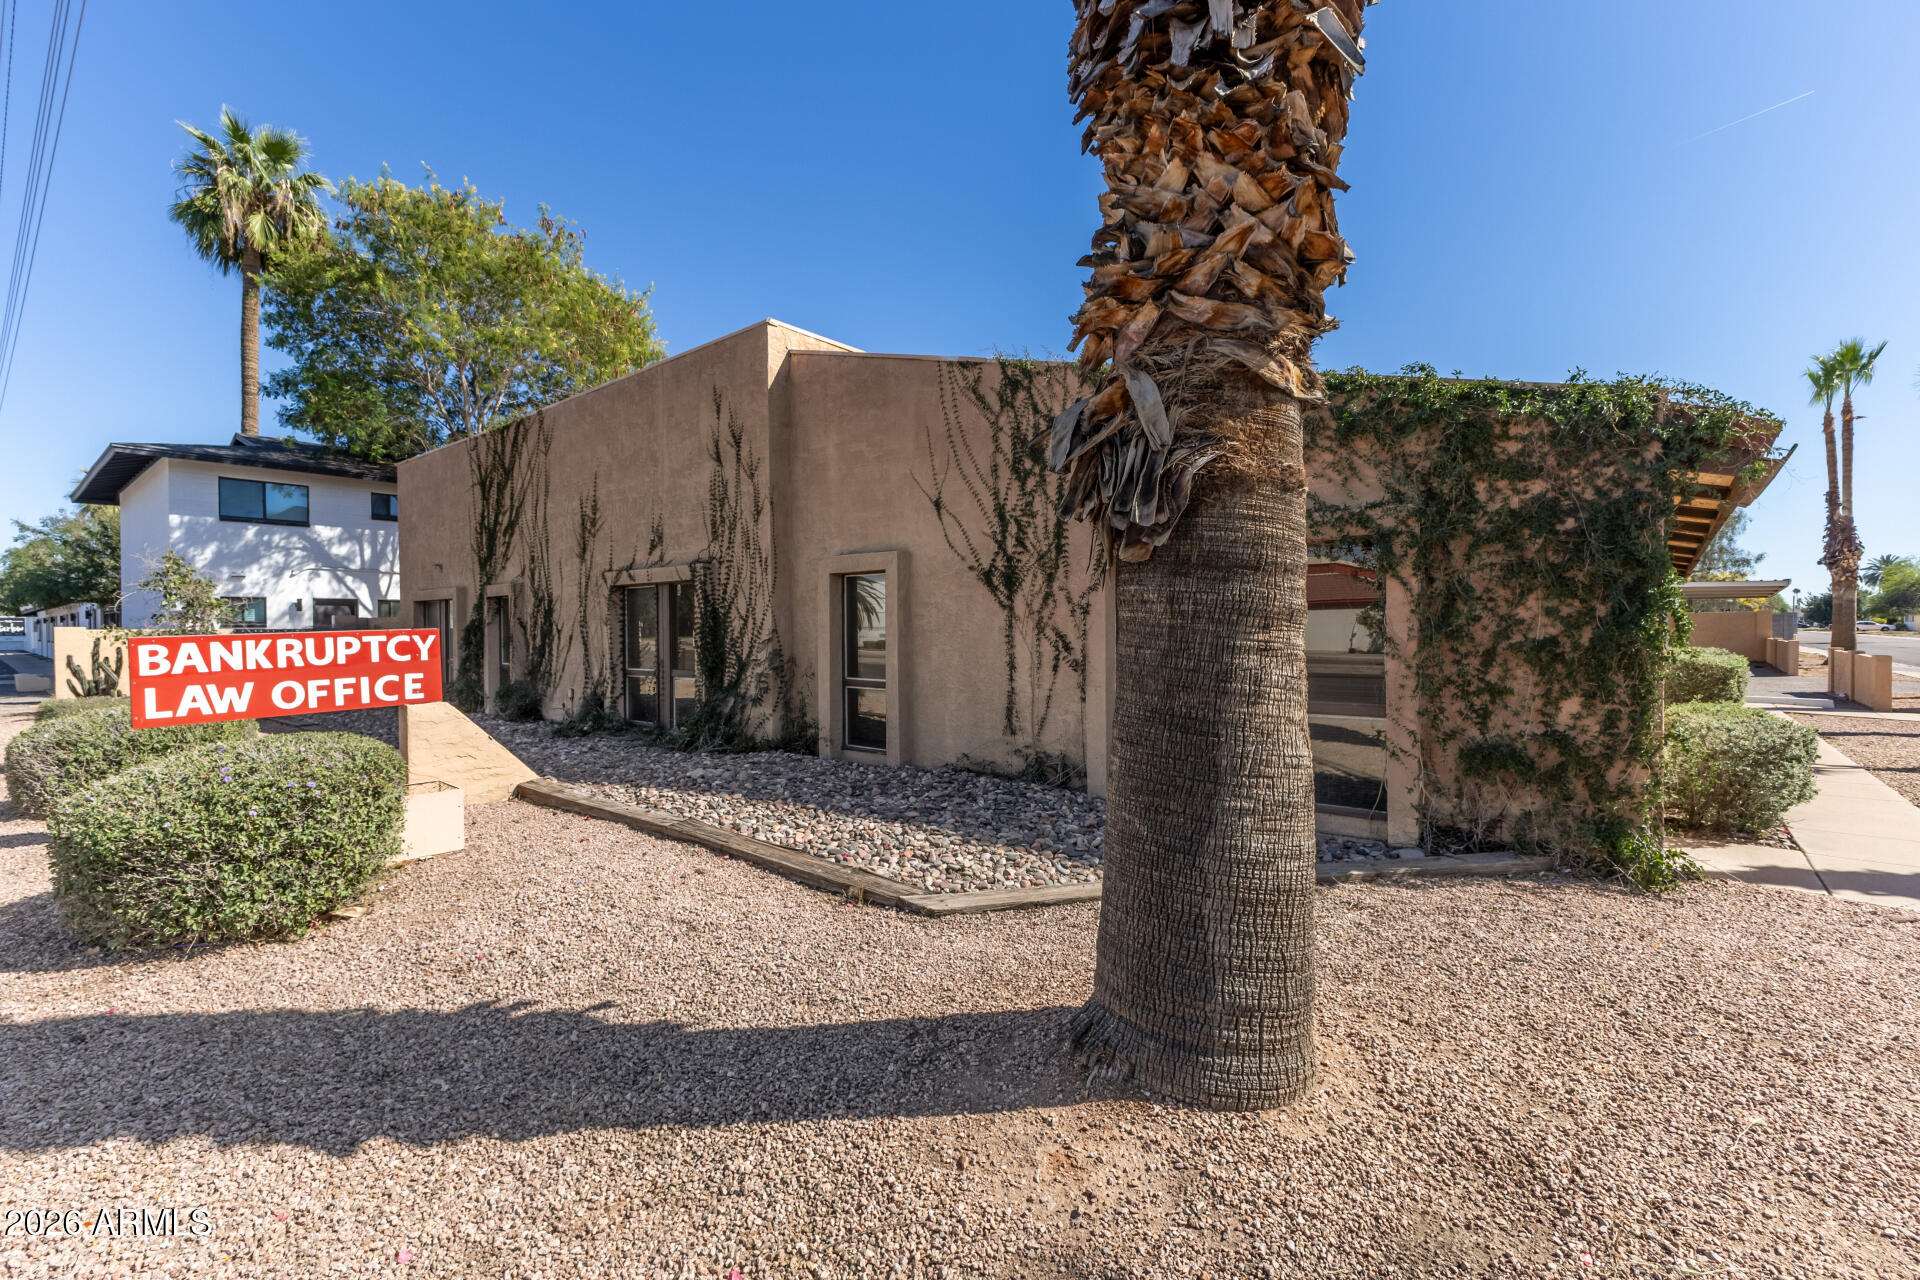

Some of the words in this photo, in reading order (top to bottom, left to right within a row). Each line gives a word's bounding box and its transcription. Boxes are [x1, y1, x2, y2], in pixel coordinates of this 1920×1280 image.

[137, 634, 436, 677] BANKRUPTCY
[144, 681, 254, 720] LAW
[271, 672, 425, 710] OFFICE
